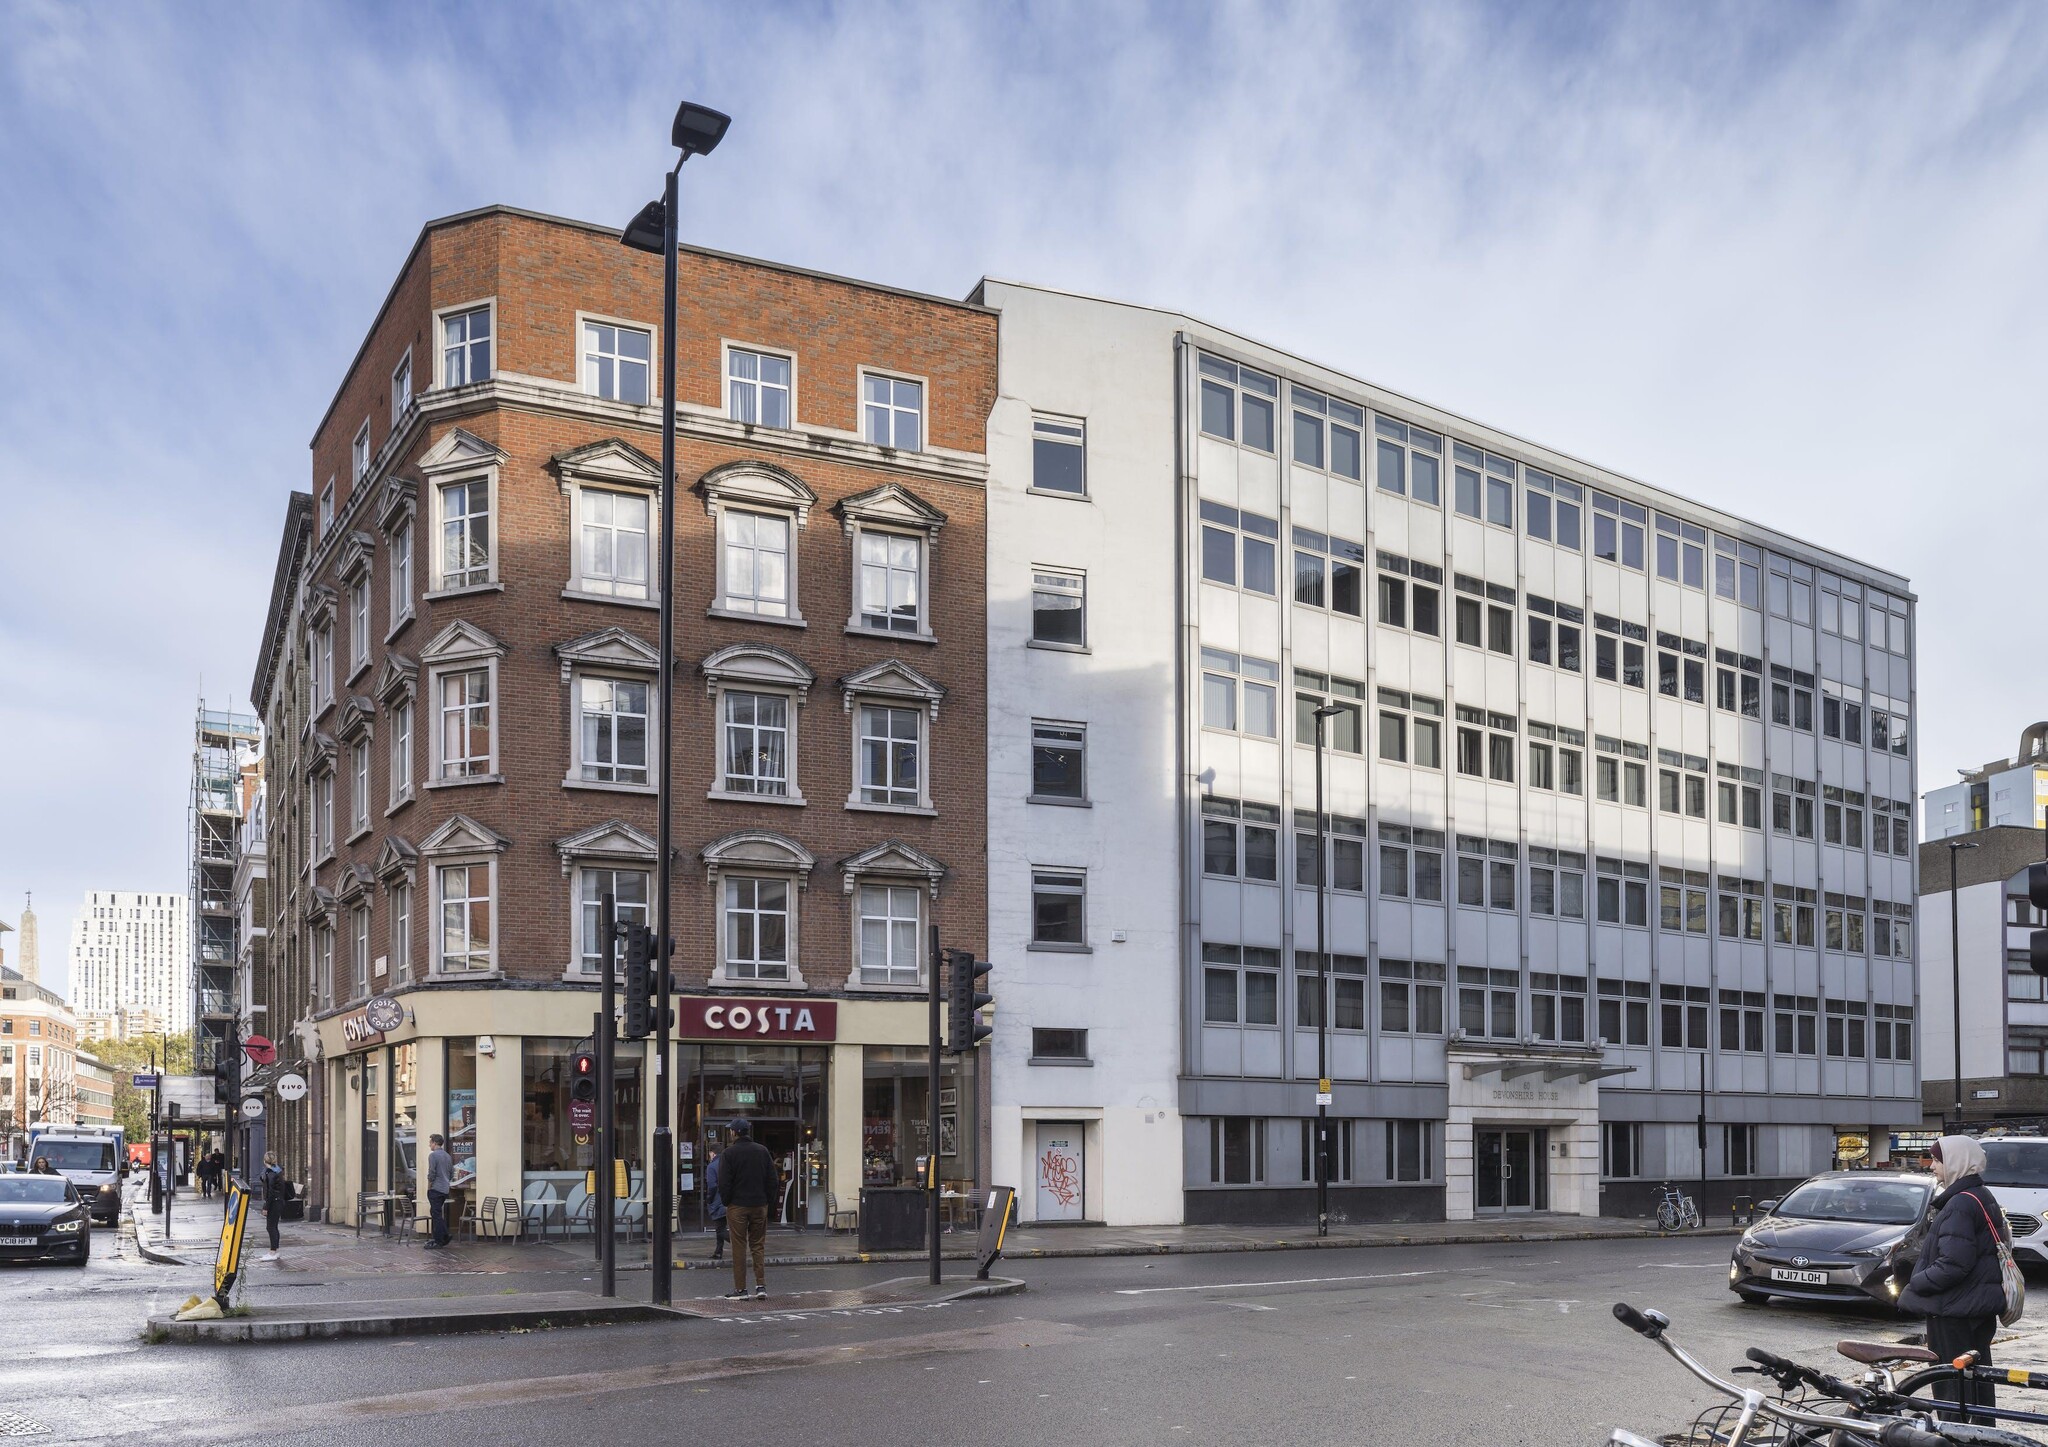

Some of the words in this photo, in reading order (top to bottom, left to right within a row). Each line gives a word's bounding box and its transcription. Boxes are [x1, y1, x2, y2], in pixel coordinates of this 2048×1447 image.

[373, 1000, 396, 1010] COSTA
[372, 1016, 399, 1028] COFFEE
[705, 1005, 816, 1034] COSTA
[1523, 1082, 1531, 1090] 60
[1493, 1090, 1534, 1100] DEVONSHIRE
[1538, 1091, 1559, 1100] HOUSE
[1777, 1270, 1799, 1280] NJ17
[1801, 1272, 1821, 1282] LOH
